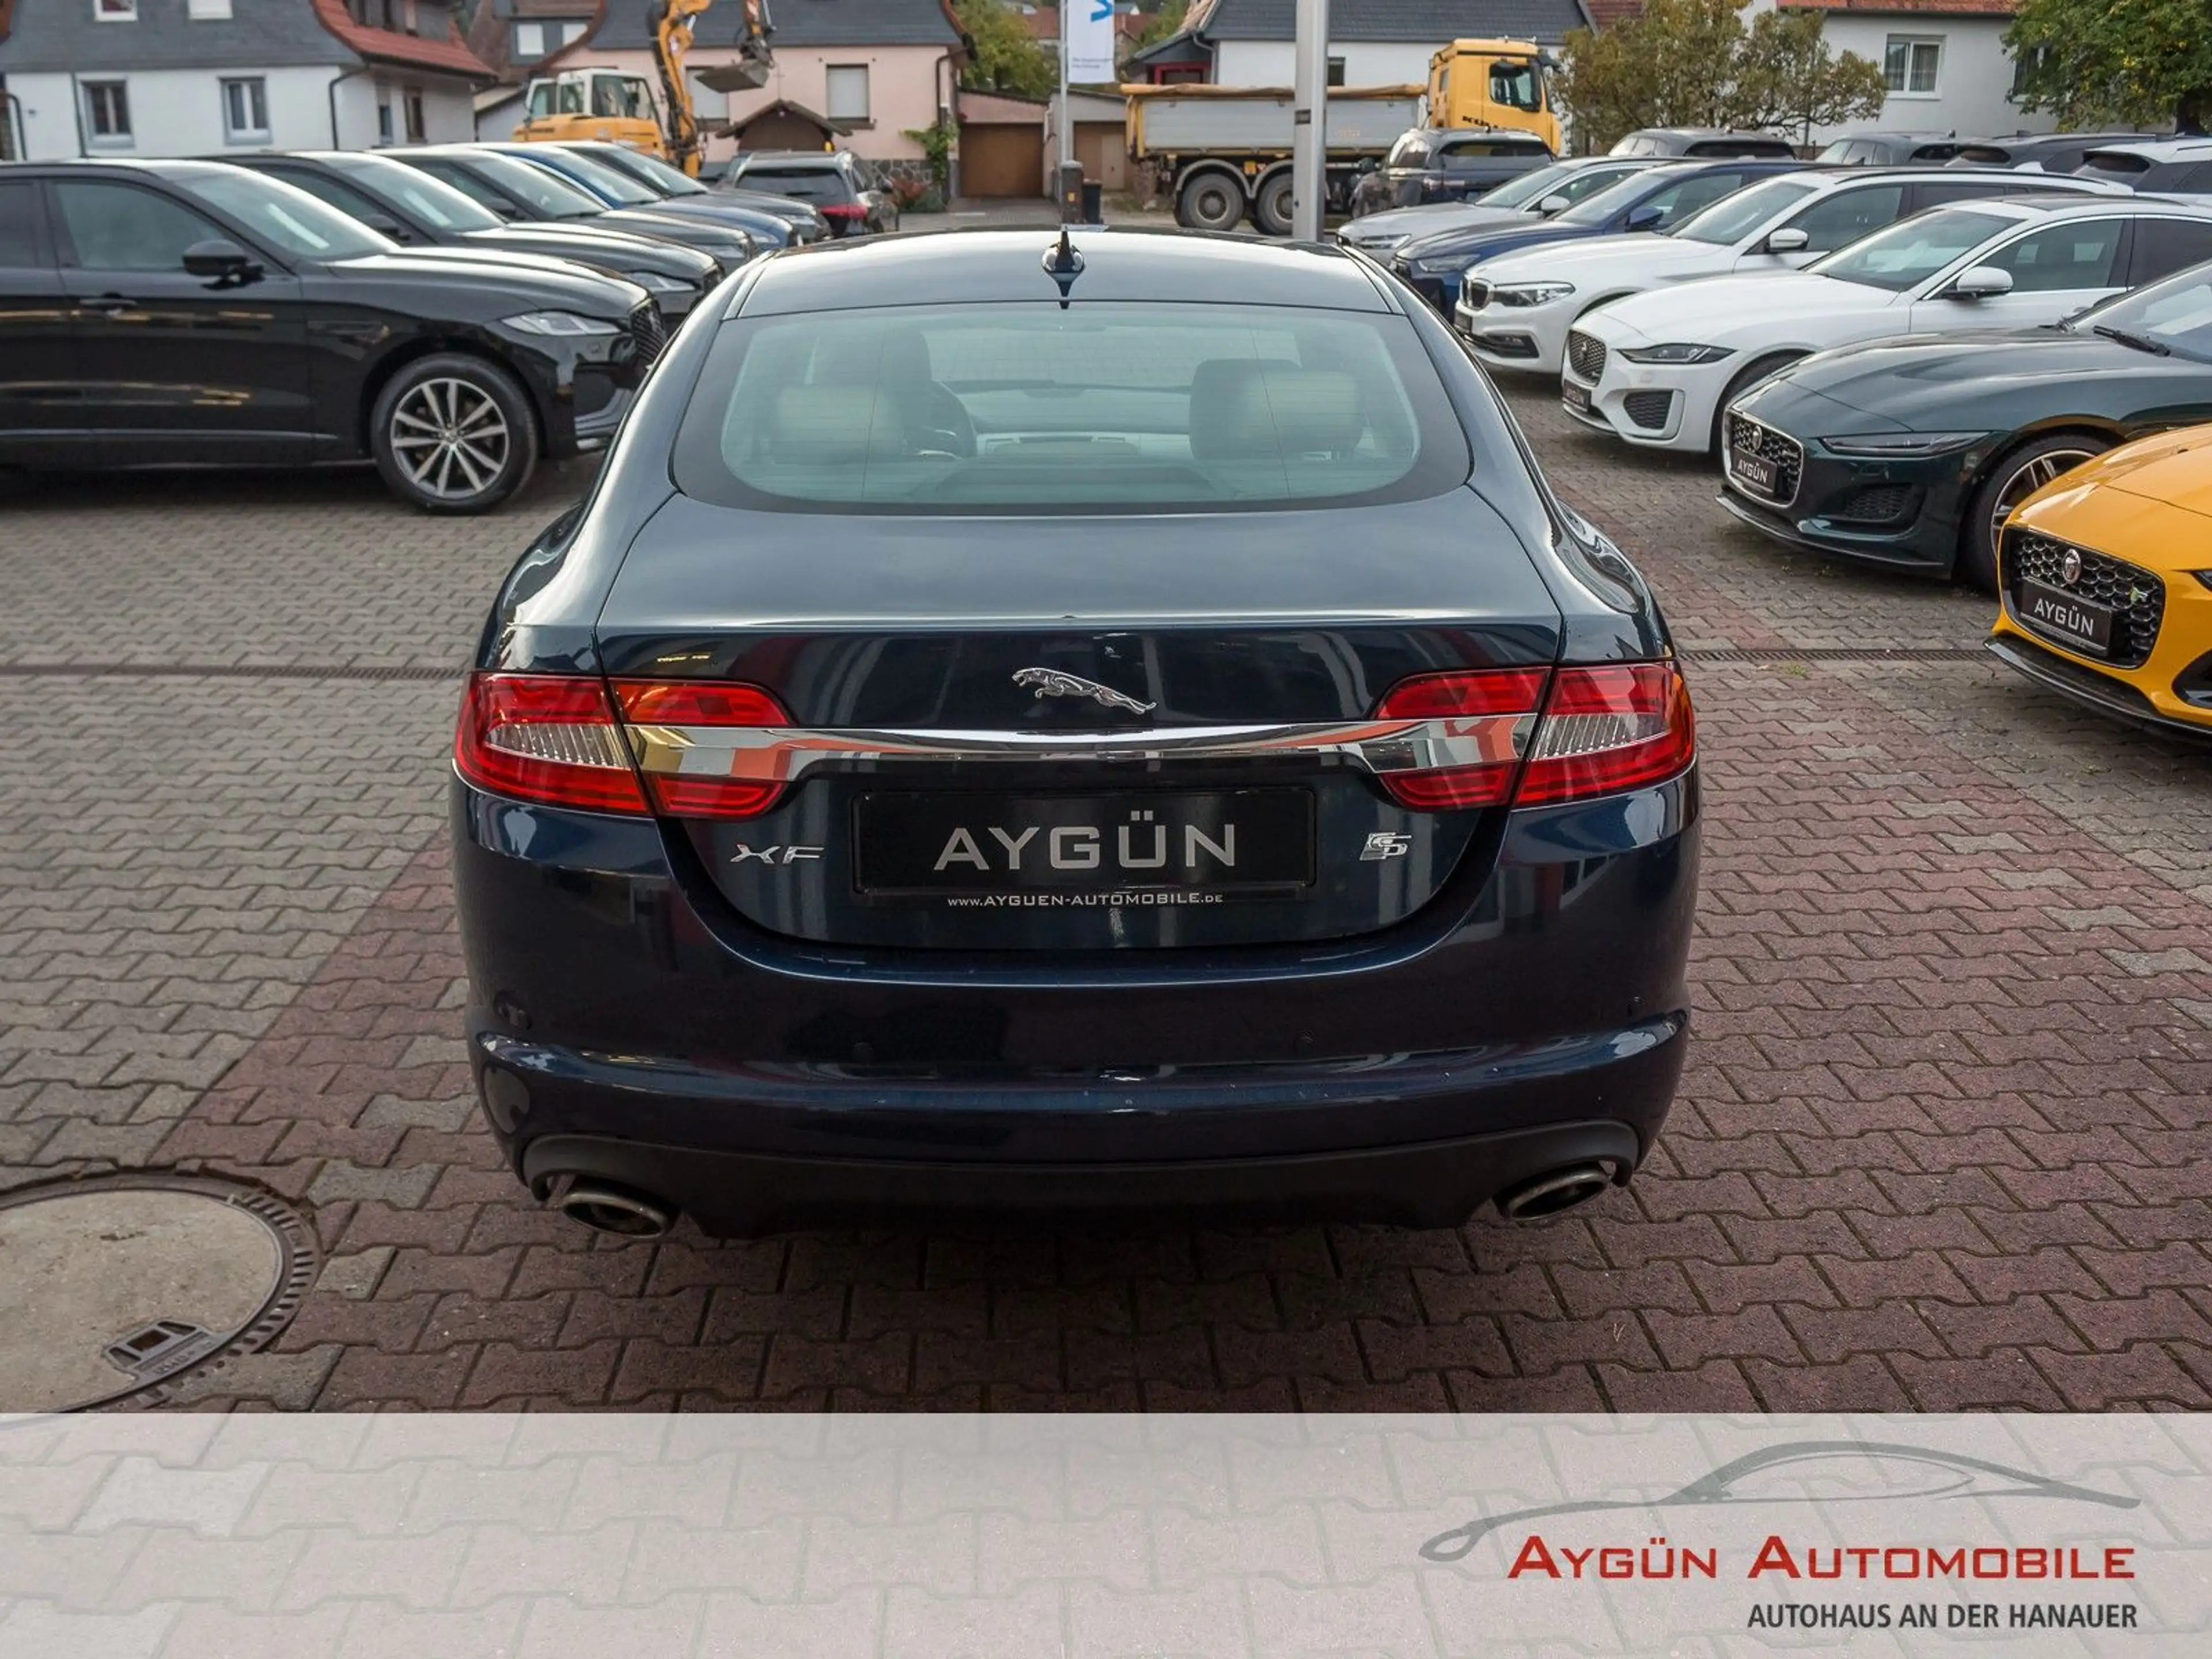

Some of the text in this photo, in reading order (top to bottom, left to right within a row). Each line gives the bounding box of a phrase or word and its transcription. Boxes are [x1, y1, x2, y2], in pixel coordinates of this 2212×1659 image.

[1738, 459, 1768, 483] AYGÜN
[2035, 598, 2093, 636] AYGÜN
[730, 843, 825, 865] XF
[933, 810, 1235, 871] AYGÜN
